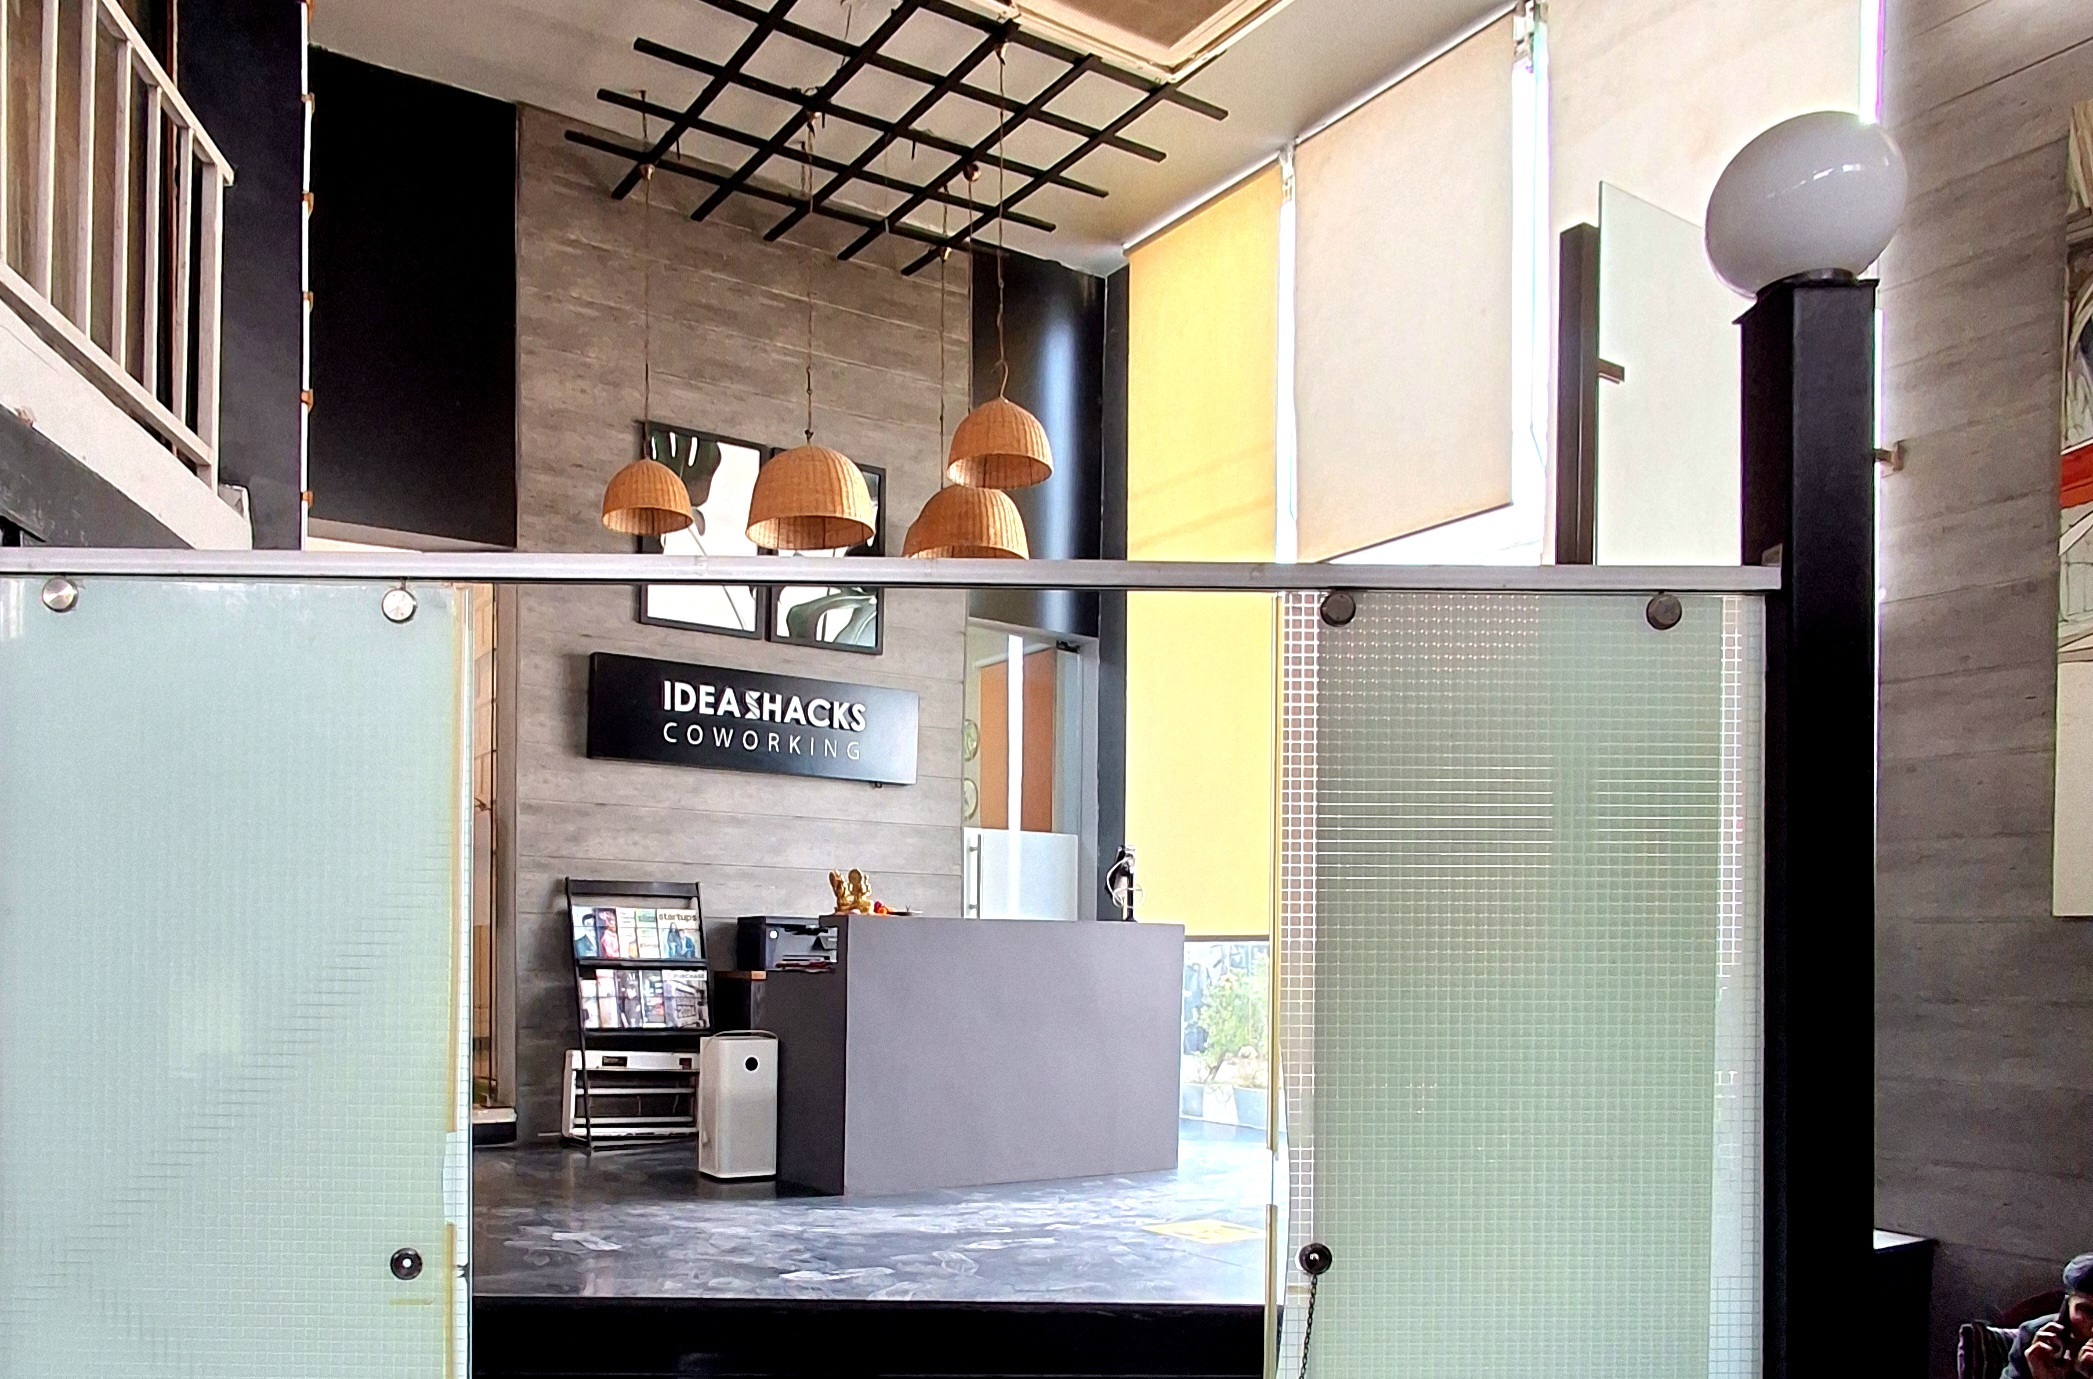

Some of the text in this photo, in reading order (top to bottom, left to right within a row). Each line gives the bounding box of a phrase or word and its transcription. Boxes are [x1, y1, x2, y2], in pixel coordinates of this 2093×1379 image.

[663, 680, 867, 732] IDEASHACKS
[663, 722, 860, 760] COWORKING
[659, 913, 697, 922] startups
